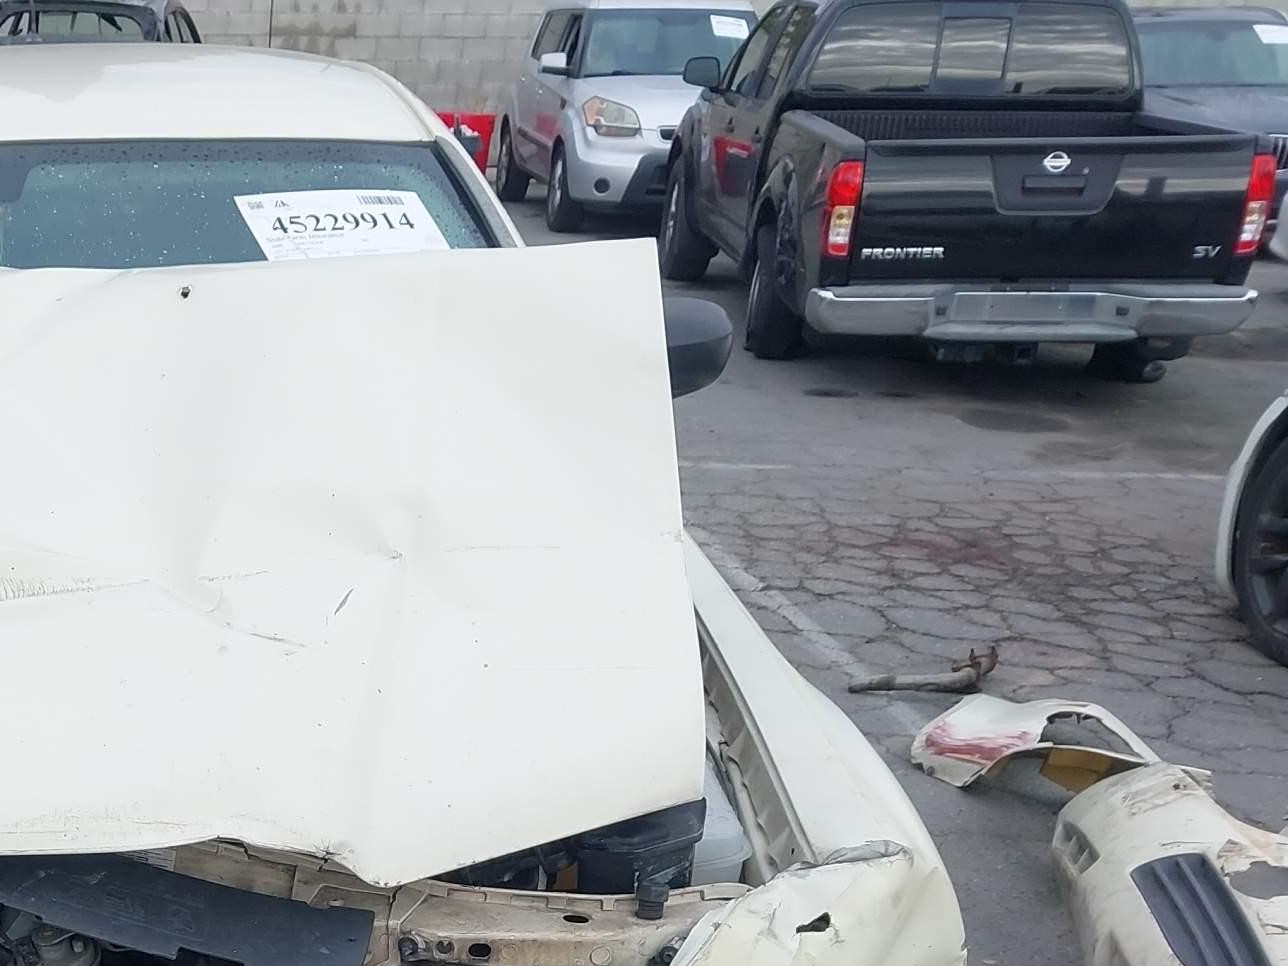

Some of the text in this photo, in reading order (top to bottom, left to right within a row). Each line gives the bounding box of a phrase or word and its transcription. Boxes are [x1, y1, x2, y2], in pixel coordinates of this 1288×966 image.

[272, 212, 415, 234] 45229914
[861, 245, 1221, 260] FRONTIER SV
